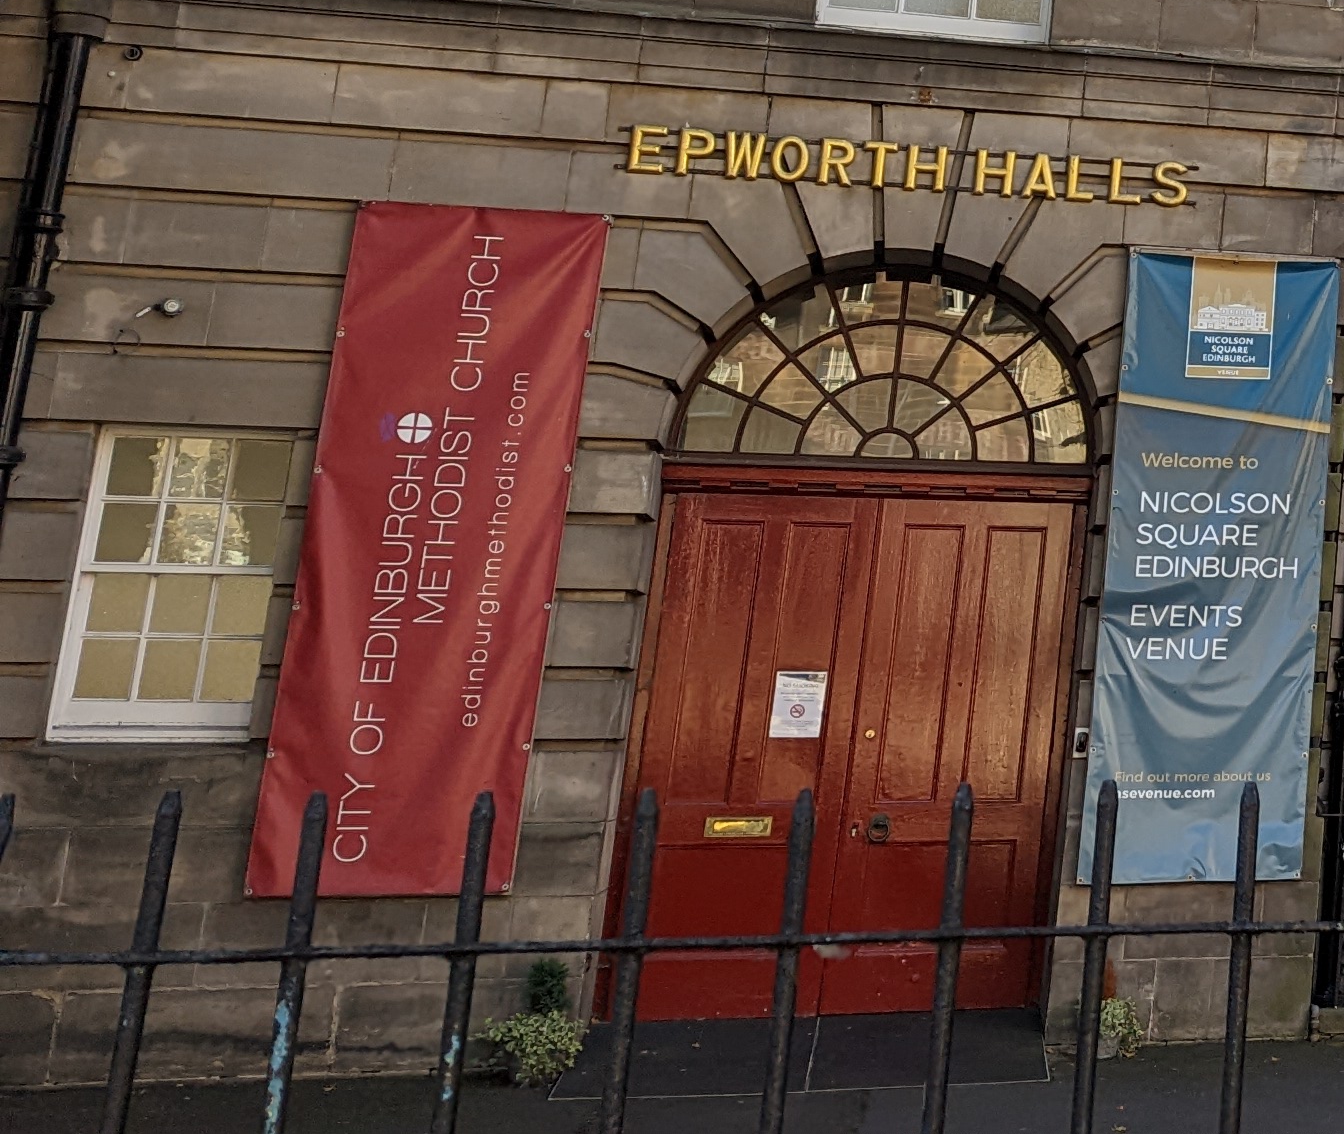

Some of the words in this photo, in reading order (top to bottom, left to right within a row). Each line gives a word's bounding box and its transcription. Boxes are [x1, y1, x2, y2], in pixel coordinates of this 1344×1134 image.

[626, 124, 948, 193] EPWORTH
[974, 147, 1190, 207] HALLS
[1203, 335, 1254, 345] NICOLSON
[1210, 345, 1248, 354] SQUARE
[1202, 354, 1256, 363] EDINBURGH
[412, 406, 476, 624] METHODIST
[449, 233, 505, 393] CHURCH
[1141, 451, 1233, 470] Welcome
[1238, 454, 1259, 470] to
[1139, 490, 1291, 516] NICOLSON
[1136, 522, 1259, 549] SQUARE
[461, 370, 531, 728] edinburghmethodist.com
[360, 454, 426, 685] EDINBURGH
[1134, 555, 1299, 580] EDINBURGH
[1129, 603, 1243, 629] EVENTS
[1125, 635, 1229, 661] VENUE
[349, 701, 387, 756] OF
[1115, 771, 1144, 782] Find
[1147, 772, 1170, 783] out
[1174, 772, 1210, 782] more
[1213, 770, 1253, 782] about
[1256, 772, 1271, 781] us
[332, 772, 375, 863] CITY
